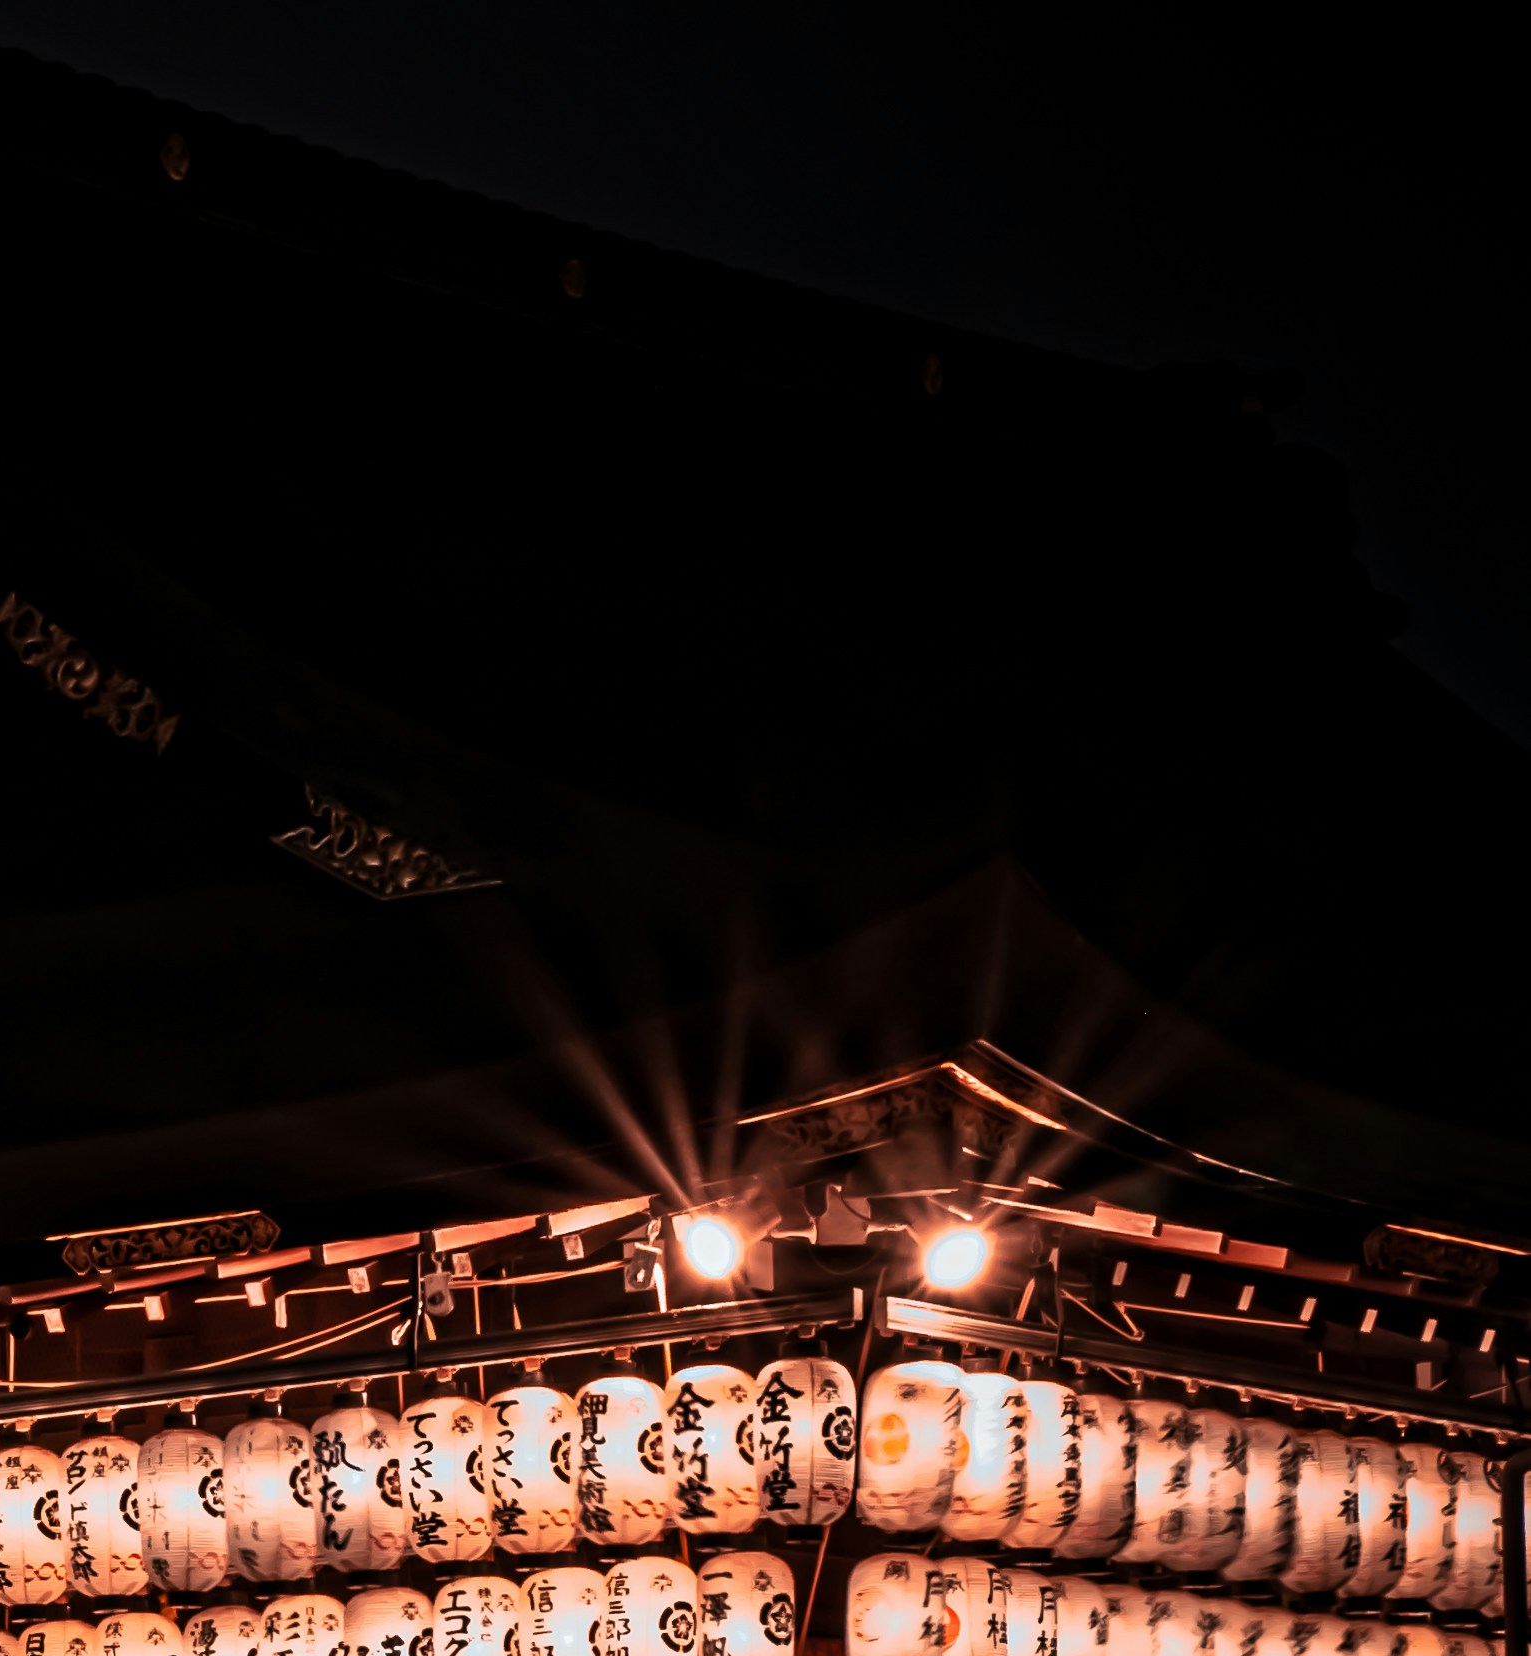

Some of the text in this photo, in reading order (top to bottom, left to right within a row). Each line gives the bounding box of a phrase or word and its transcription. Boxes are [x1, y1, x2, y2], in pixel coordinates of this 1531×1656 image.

[407, 1411, 448, 1548] てっさい堂
[490, 1400, 529, 1537] てっさい堂
[666, 1382, 716, 1520] 金竹堂
[756, 1371, 804, 1512] 金竹堂
